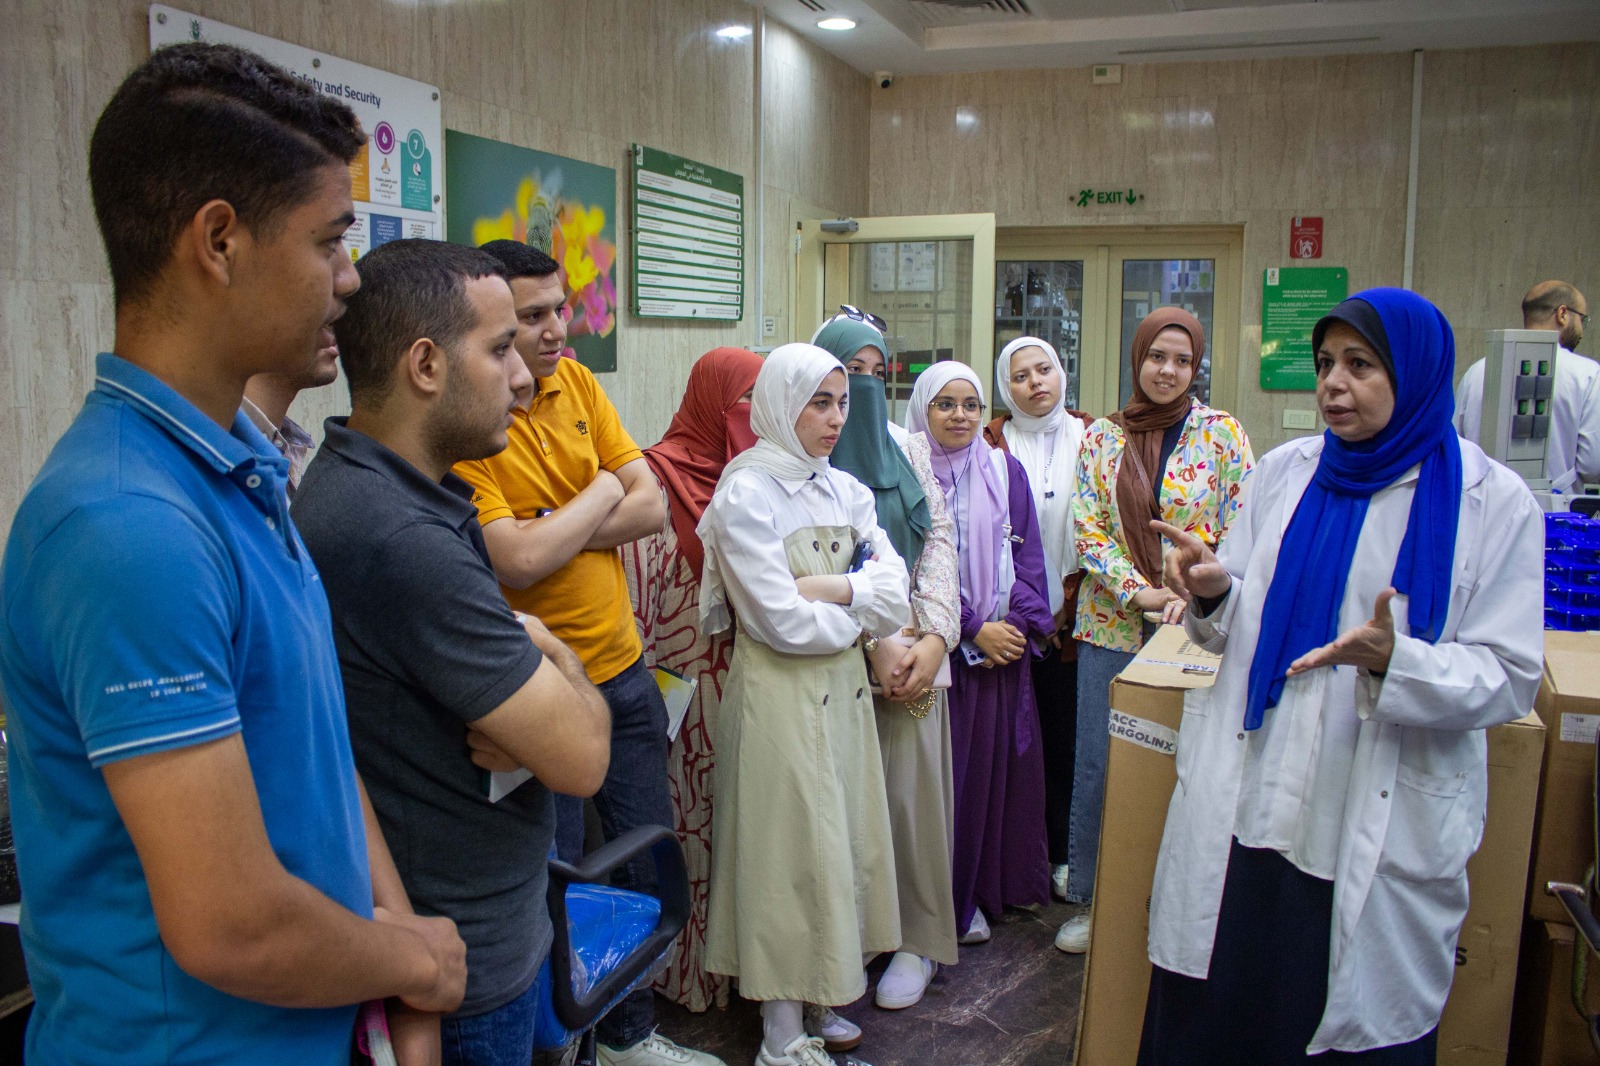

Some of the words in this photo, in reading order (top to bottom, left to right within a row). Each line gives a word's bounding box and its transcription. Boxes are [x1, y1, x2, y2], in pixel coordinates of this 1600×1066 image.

[325, 83, 342, 96] and
[345, 86, 381, 109] Security
[382, 132, 388, 144] 6
[413, 140, 419, 150] 7
[1098, 191, 1123, 204] EXIT
